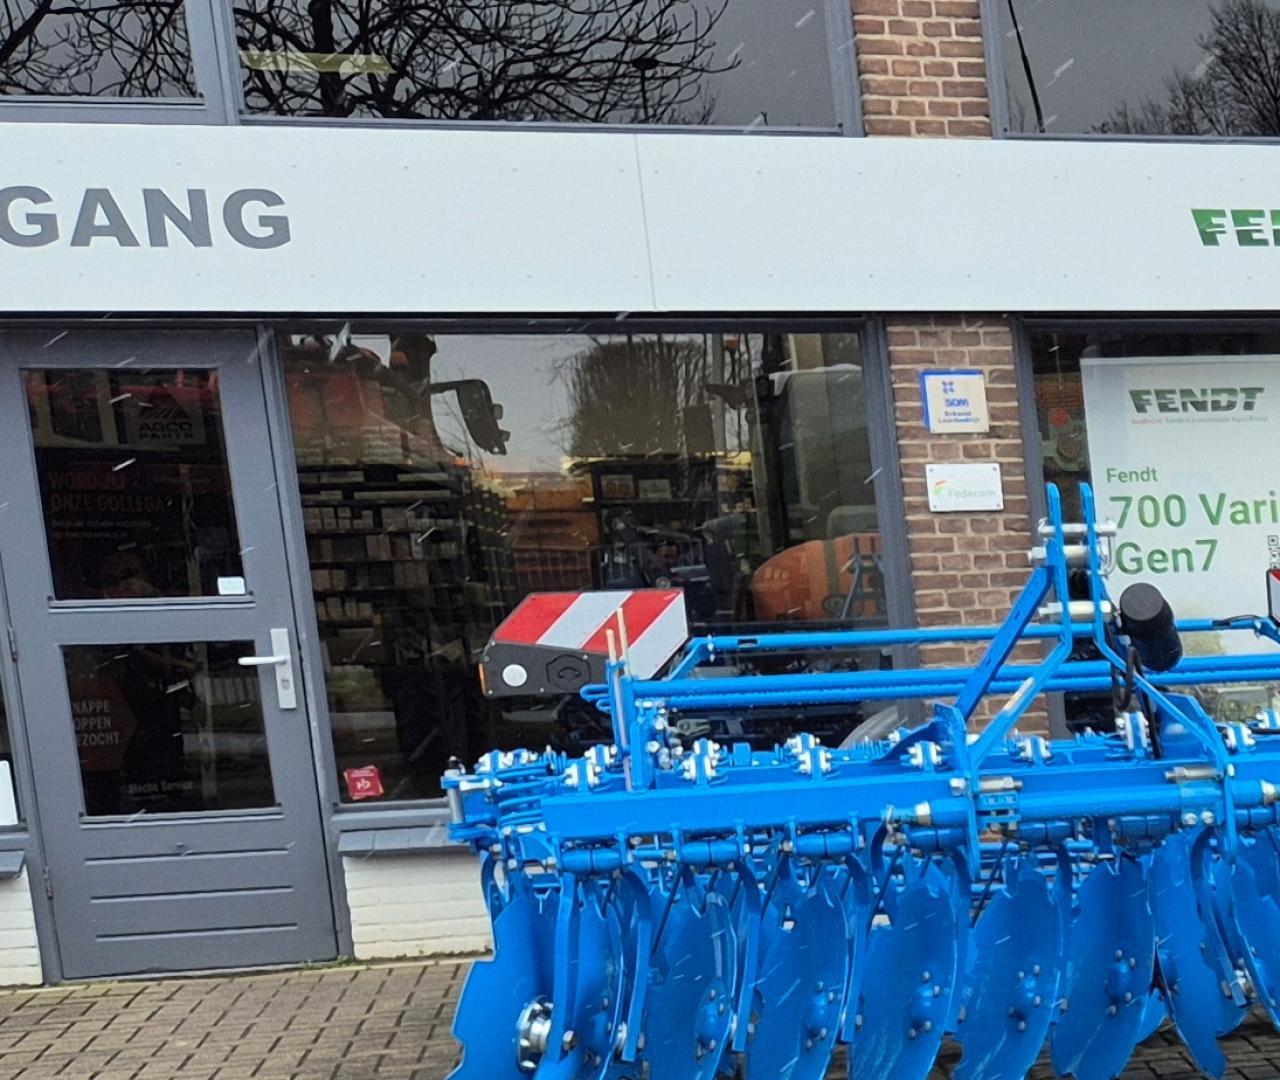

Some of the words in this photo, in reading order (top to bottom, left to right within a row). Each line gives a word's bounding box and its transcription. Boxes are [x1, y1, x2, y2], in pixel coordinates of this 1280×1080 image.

[1129, 387, 1265, 413] FENDT
[1106, 467, 1158, 483] Fendt
[1109, 494, 1187, 529] 700
[1115, 539, 1218, 575] Gen7
